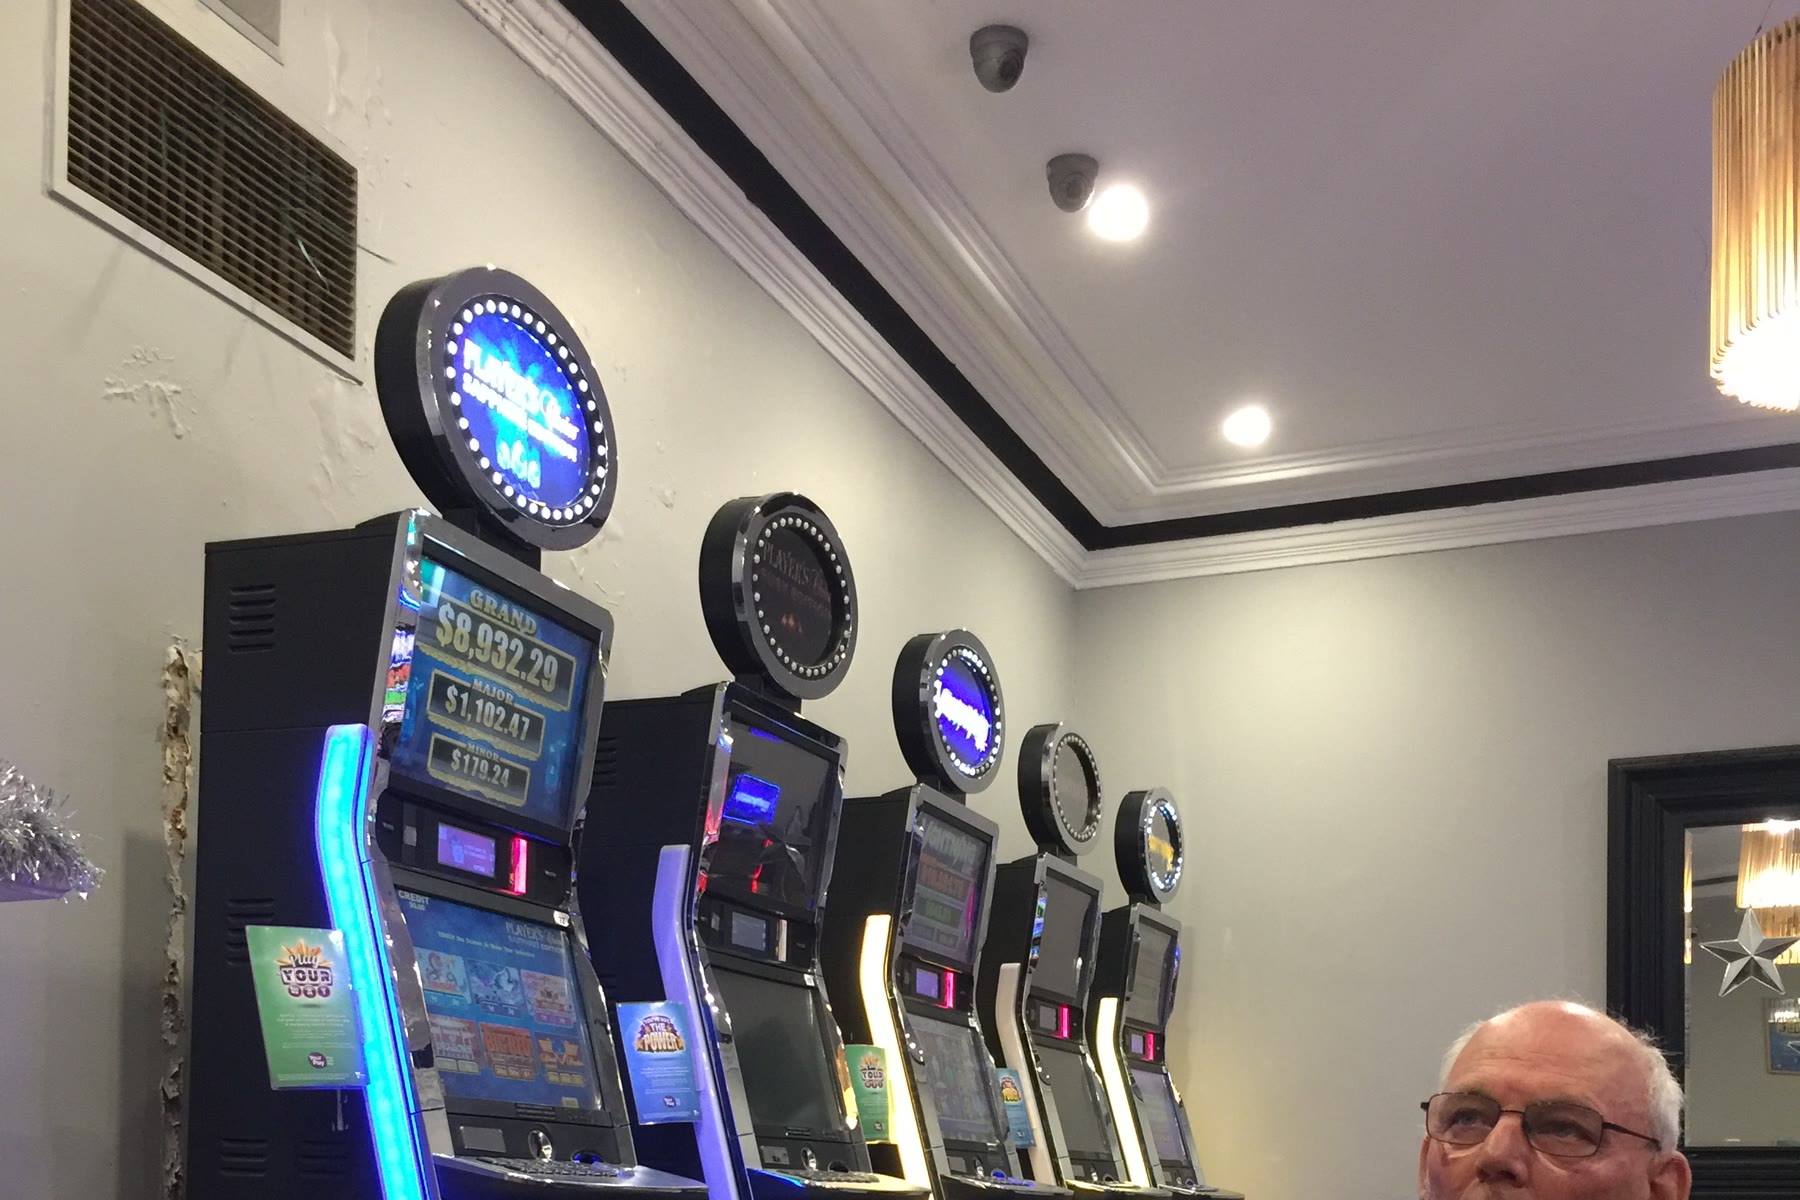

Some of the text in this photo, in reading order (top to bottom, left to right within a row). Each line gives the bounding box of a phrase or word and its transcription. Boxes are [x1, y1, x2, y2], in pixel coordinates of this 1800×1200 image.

[470, 588, 538, 635] GRAND
[435, 602, 559, 693] $8,932.29
[472, 678, 515, 706] MAJOR
[445, 684, 530, 742] $1,102.47
[466, 742, 501, 762] MINOR
[450, 747, 511, 788] $179.24
[398, 889, 431, 905] CREDIT
[288, 954, 320, 968] Play
[282, 969, 331, 982] YOUR
[650, 1024, 667, 1032] THE
[644, 1032, 678, 1051] POWER
